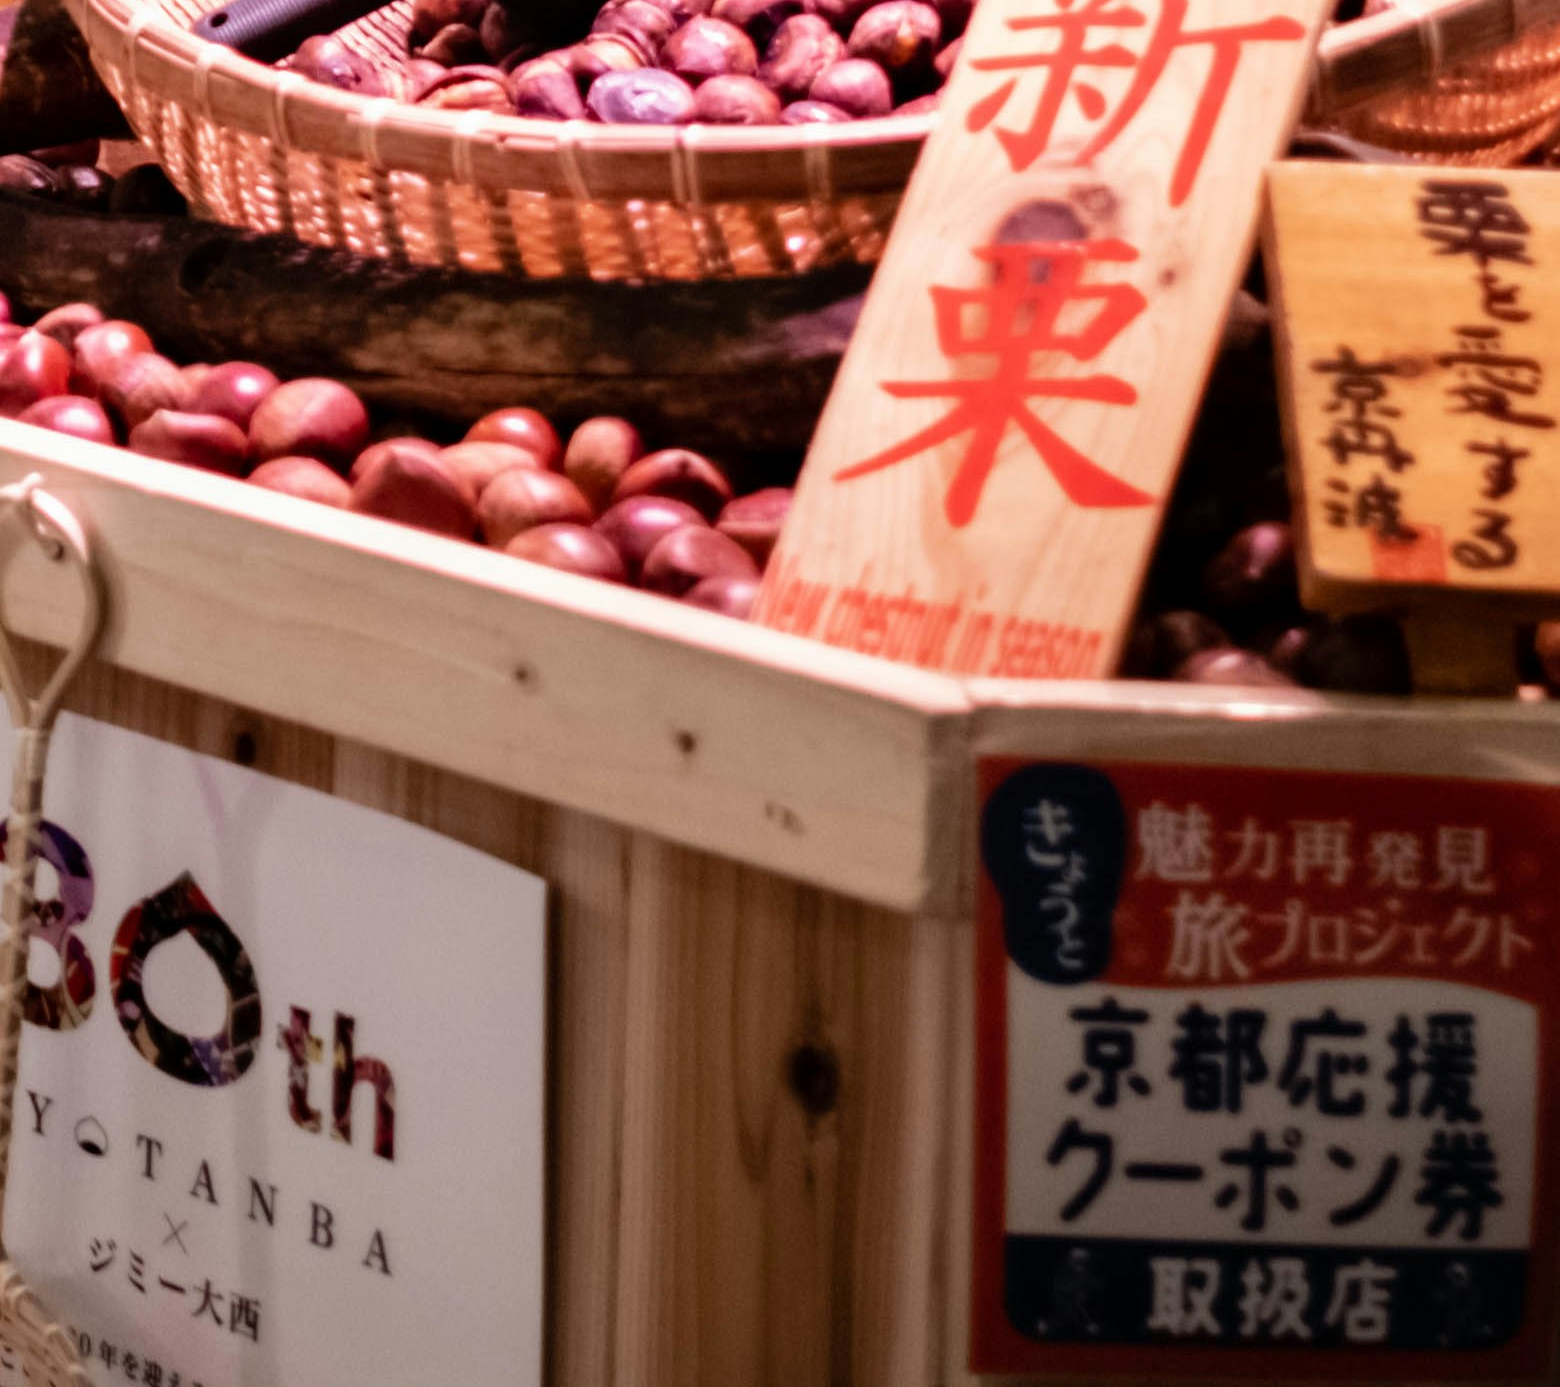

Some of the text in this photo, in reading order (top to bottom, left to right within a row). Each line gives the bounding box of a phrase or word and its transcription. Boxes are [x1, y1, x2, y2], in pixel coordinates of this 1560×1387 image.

[1311, 341, 1419, 545] 京丹波
[1022, 798, 1090, 969] きょうと
[1136, 798, 1495, 894] 魅力再発見
[1165, 889, 1536, 981] 旅プロジェクト
[1065, 997, 1485, 1125] 京都応援
[1045, 1117, 1504, 1241] クーポン券
[88, 1235, 264, 1344] ジミー大西
[1144, 1256, 1399, 1342] 取扱店
